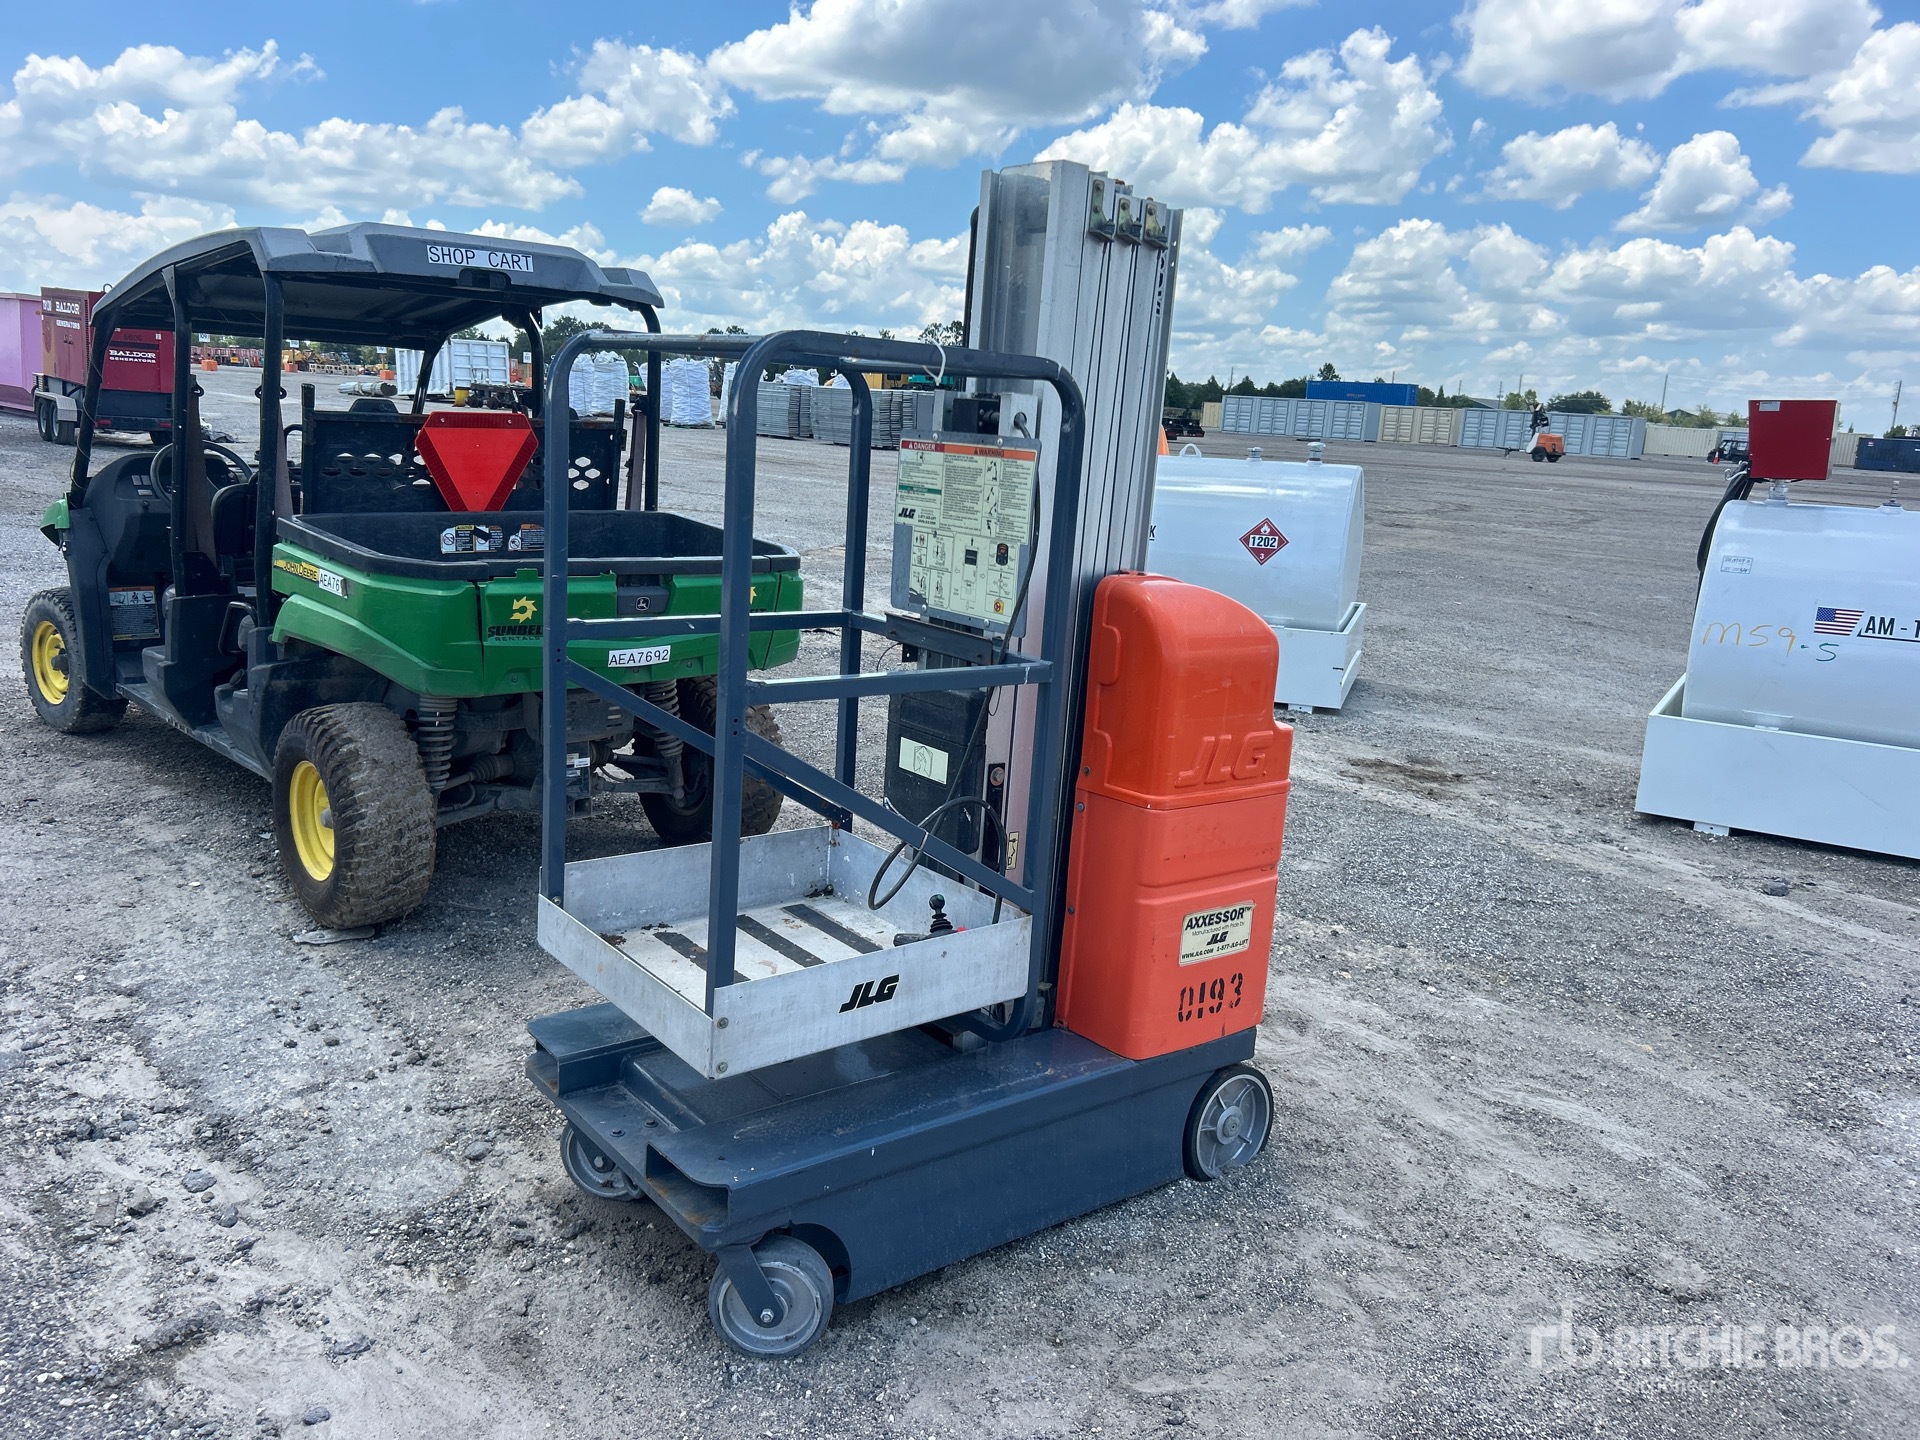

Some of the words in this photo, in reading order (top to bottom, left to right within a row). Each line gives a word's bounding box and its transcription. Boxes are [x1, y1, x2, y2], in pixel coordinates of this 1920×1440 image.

[429, 246, 476, 265] SHOP
[488, 252, 532, 271] CART
[55, 301, 80, 315] BALDOR
[109, 349, 157, 359] BALDOR
[913, 442, 936, 451] DANGER
[978, 449, 1005, 458] WARNING
[898, 507, 916, 519] JLG
[1250, 536, 1277, 548] 1202
[283, 561, 300, 575] JOHN
[299, 563, 318, 581] DEERE
[487, 624, 544, 638] SUNBEL
[1864, 615, 1895, 636] AM
[608, 649, 669, 667] AEA7692
[1174, 730, 1274, 788] JLG
[1192, 925, 1221, 936] Manufactured
[1206, 931, 1228, 945] JLG
[839, 974, 900, 1013] JLG
[1178, 972, 1243, 1022] 0193
